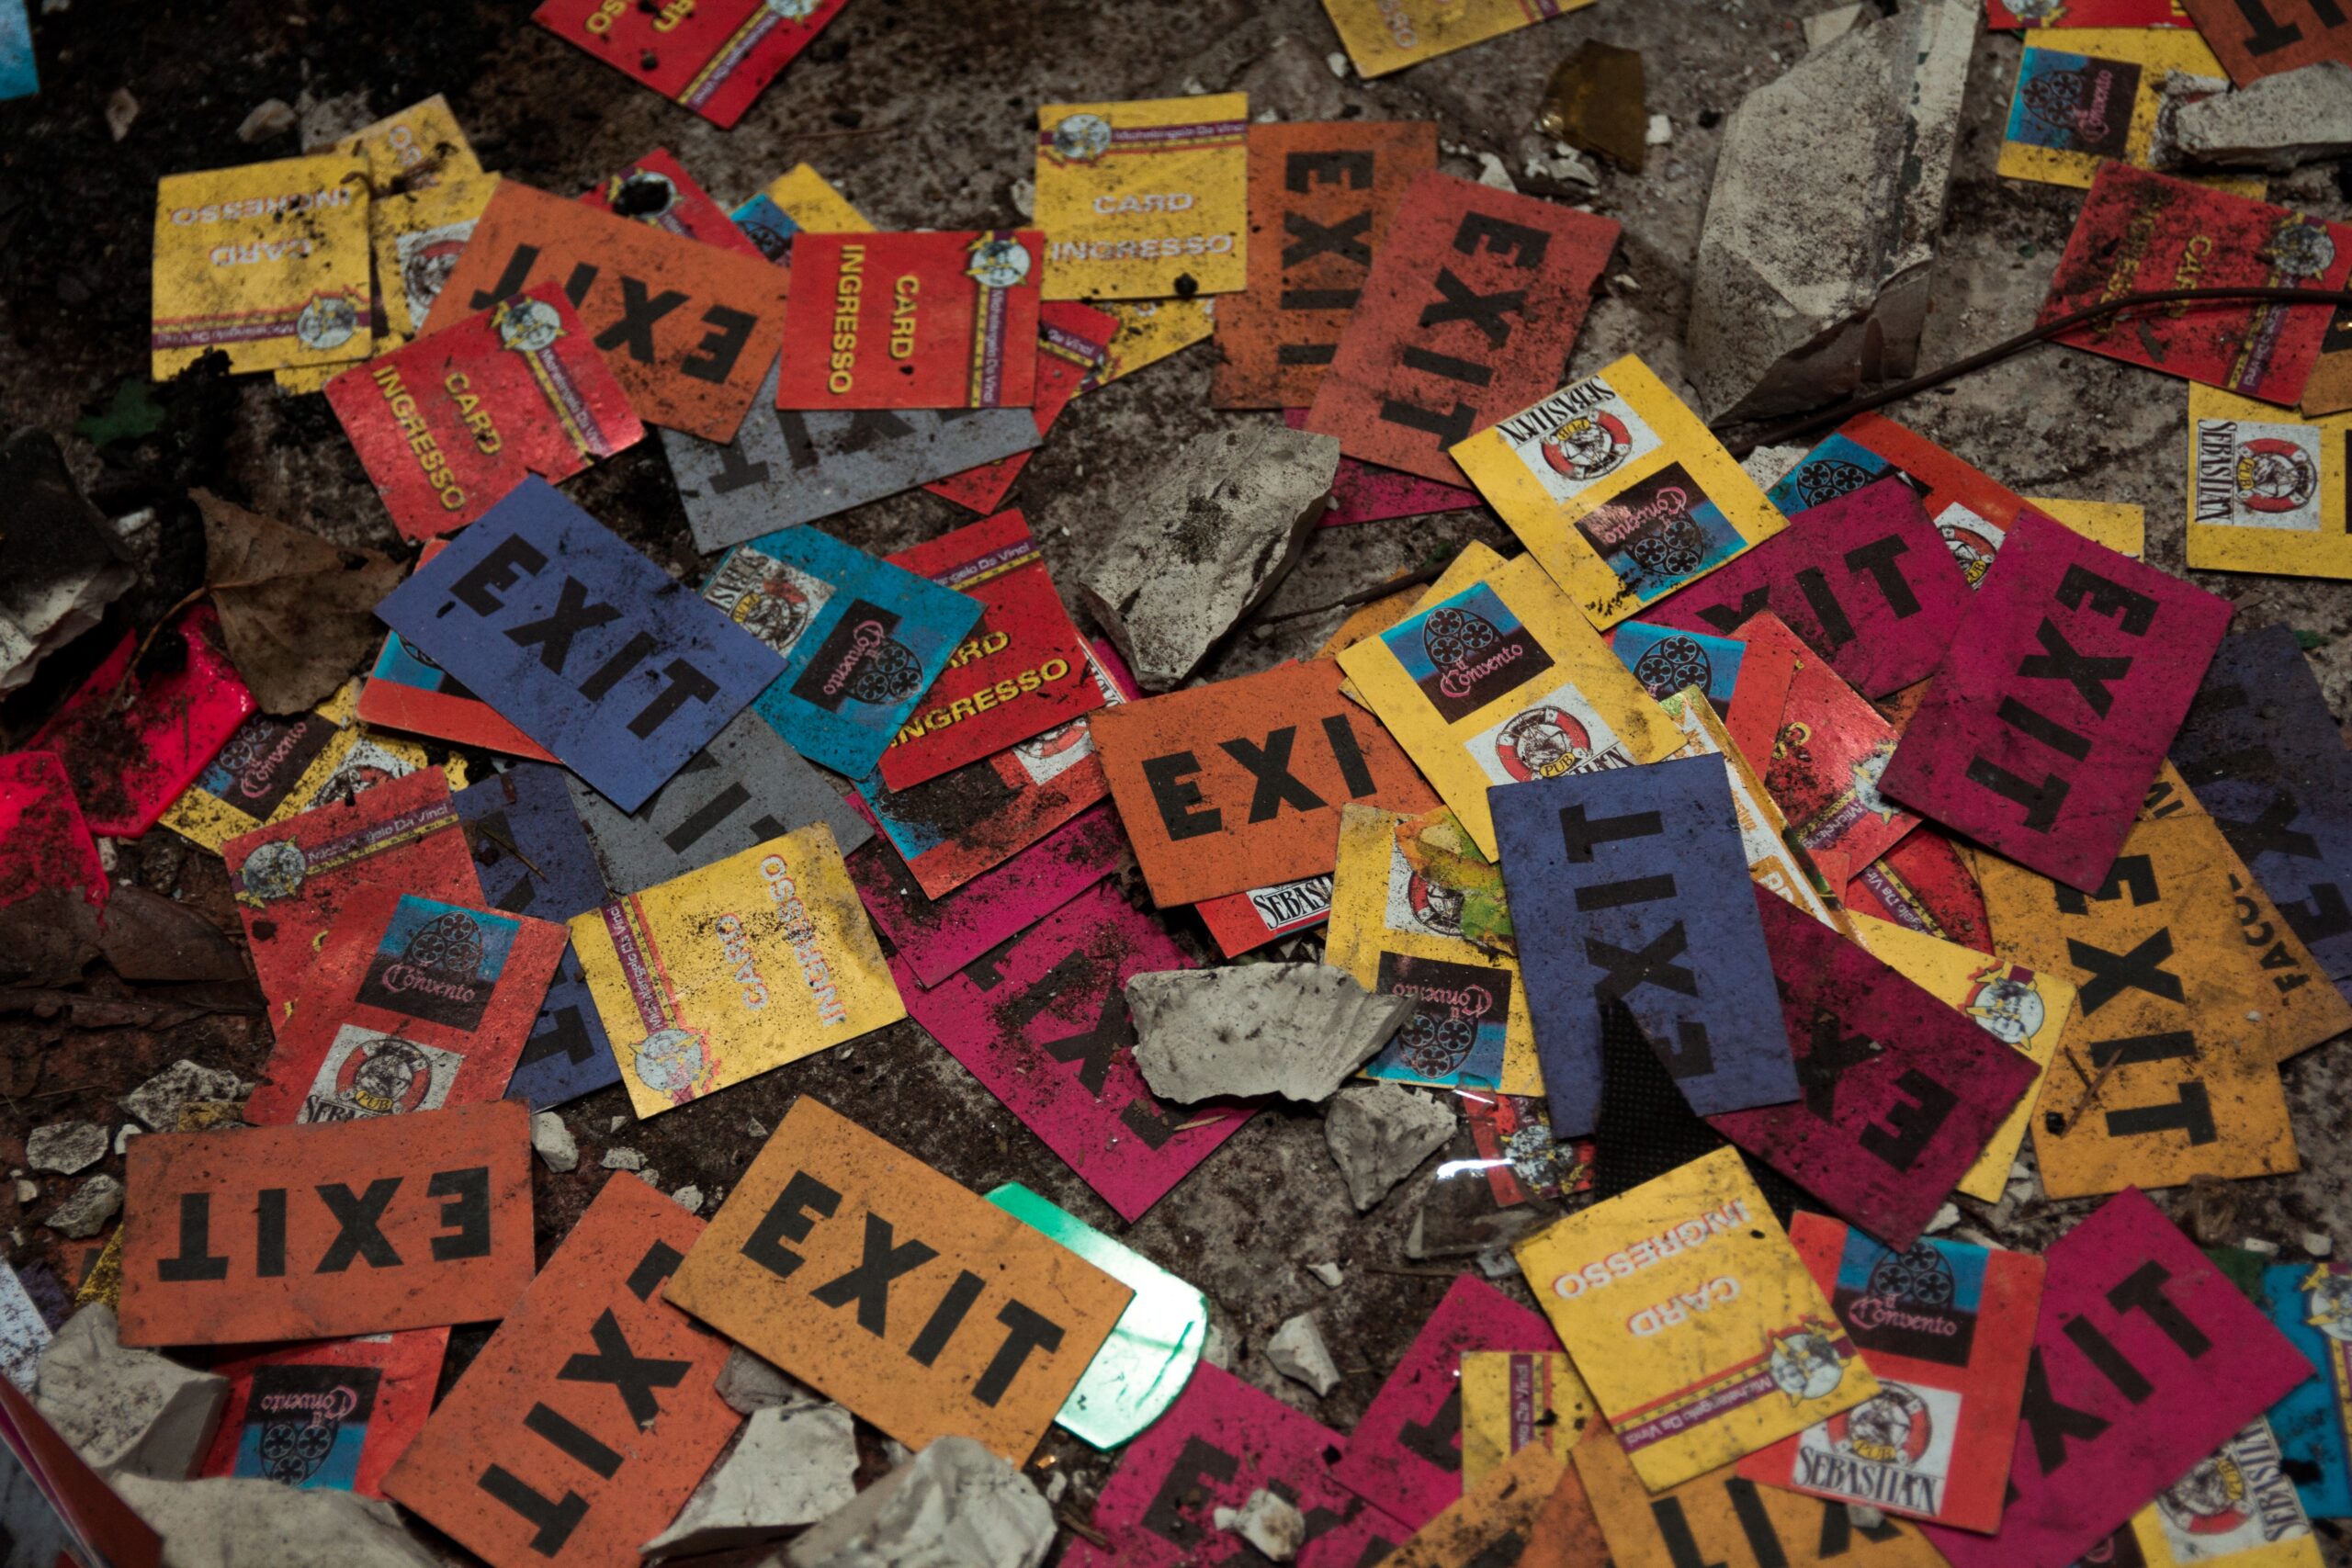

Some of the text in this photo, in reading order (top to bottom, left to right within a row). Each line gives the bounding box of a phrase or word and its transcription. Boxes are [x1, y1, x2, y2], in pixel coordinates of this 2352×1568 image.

[1093, 192, 1193, 215] CARD
[209, 237, 313, 267] CARD
[1050, 233, 1233, 261] INGRESSO
[827, 243, 866, 395] INGRESSO
[889, 274, 921, 361] CARD
[1380, 210, 1551, 451] EXIT
[372, 364, 466, 512] INGRESSO
[445, 371, 502, 456] CARD
[1556, 416, 1590, 440] PUB
[2239, 458, 2253, 487] PUB
[977, 555, 998, 570] Da
[997, 542, 1030, 561] Vinci
[449, 533, 719, 737] EXIT
[1440, 643, 1524, 698] Convento
[1966, 564, 2159, 834] EXIT
[1141, 714, 1376, 841] EXI
[1544, 756, 1574, 776] PUB
[414, 802, 449, 824] Vinci
[605, 904, 627, 936] Vinci
[759, 852, 846, 1028] INGRESSO
[715, 911, 769, 1011] CARD
[357, 1092, 390, 1110] PUB
[157, 1167, 490, 1281] EXIT
[1554, 1198, 1752, 1299] INGRESSO
[740, 1170, 1065, 1407] EXIT
[1627, 1275, 1741, 1339] CARD
[1849, 1295, 1958, 1337] Convento
[260, 1384, 358, 1421] Convento
[479, 1240, 712, 1559] XIT
[2012, 1260, 2212, 1488] XIT
[1623, 1420, 1662, 1450] Vinci
[1855, 1439, 1894, 1458] PUB
